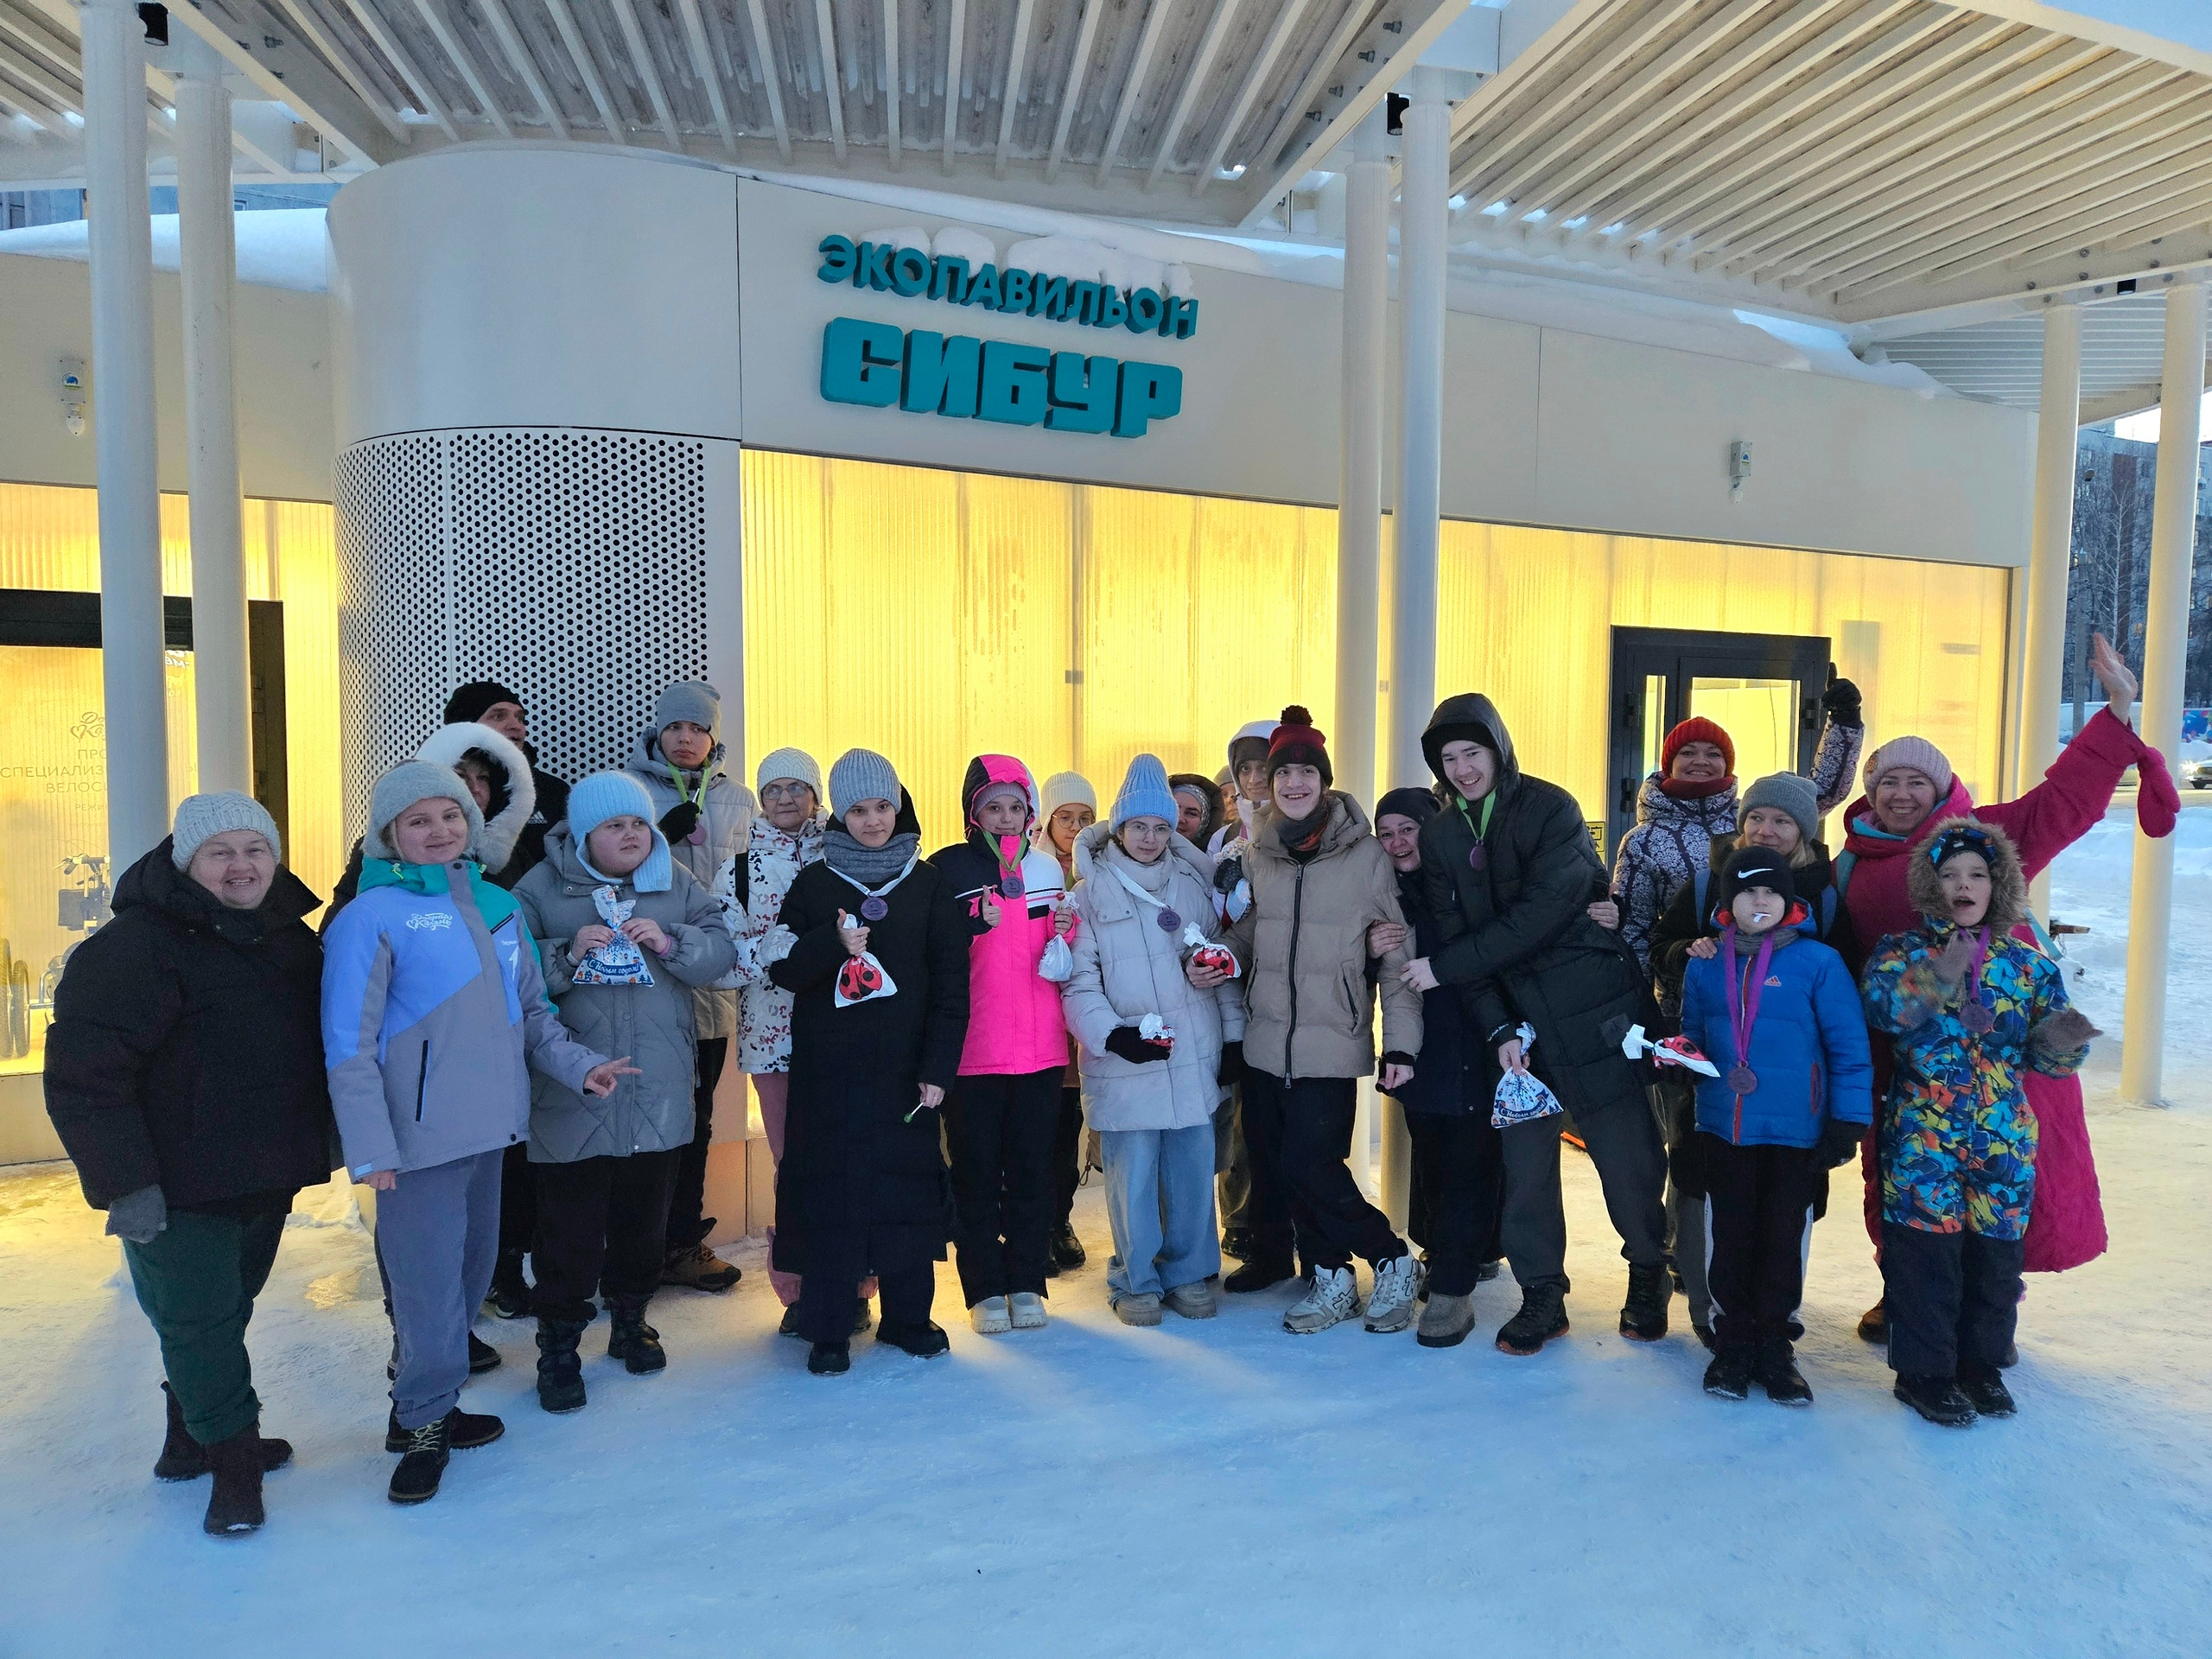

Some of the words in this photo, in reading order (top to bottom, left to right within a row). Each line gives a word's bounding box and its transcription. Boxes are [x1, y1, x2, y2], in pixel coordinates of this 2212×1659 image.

[817, 234, 1199, 340] ЭКОПАВИЛЬОН
[820, 316, 1184, 439] СИБУР
[46, 781, 107, 793] ВЕЛОС
